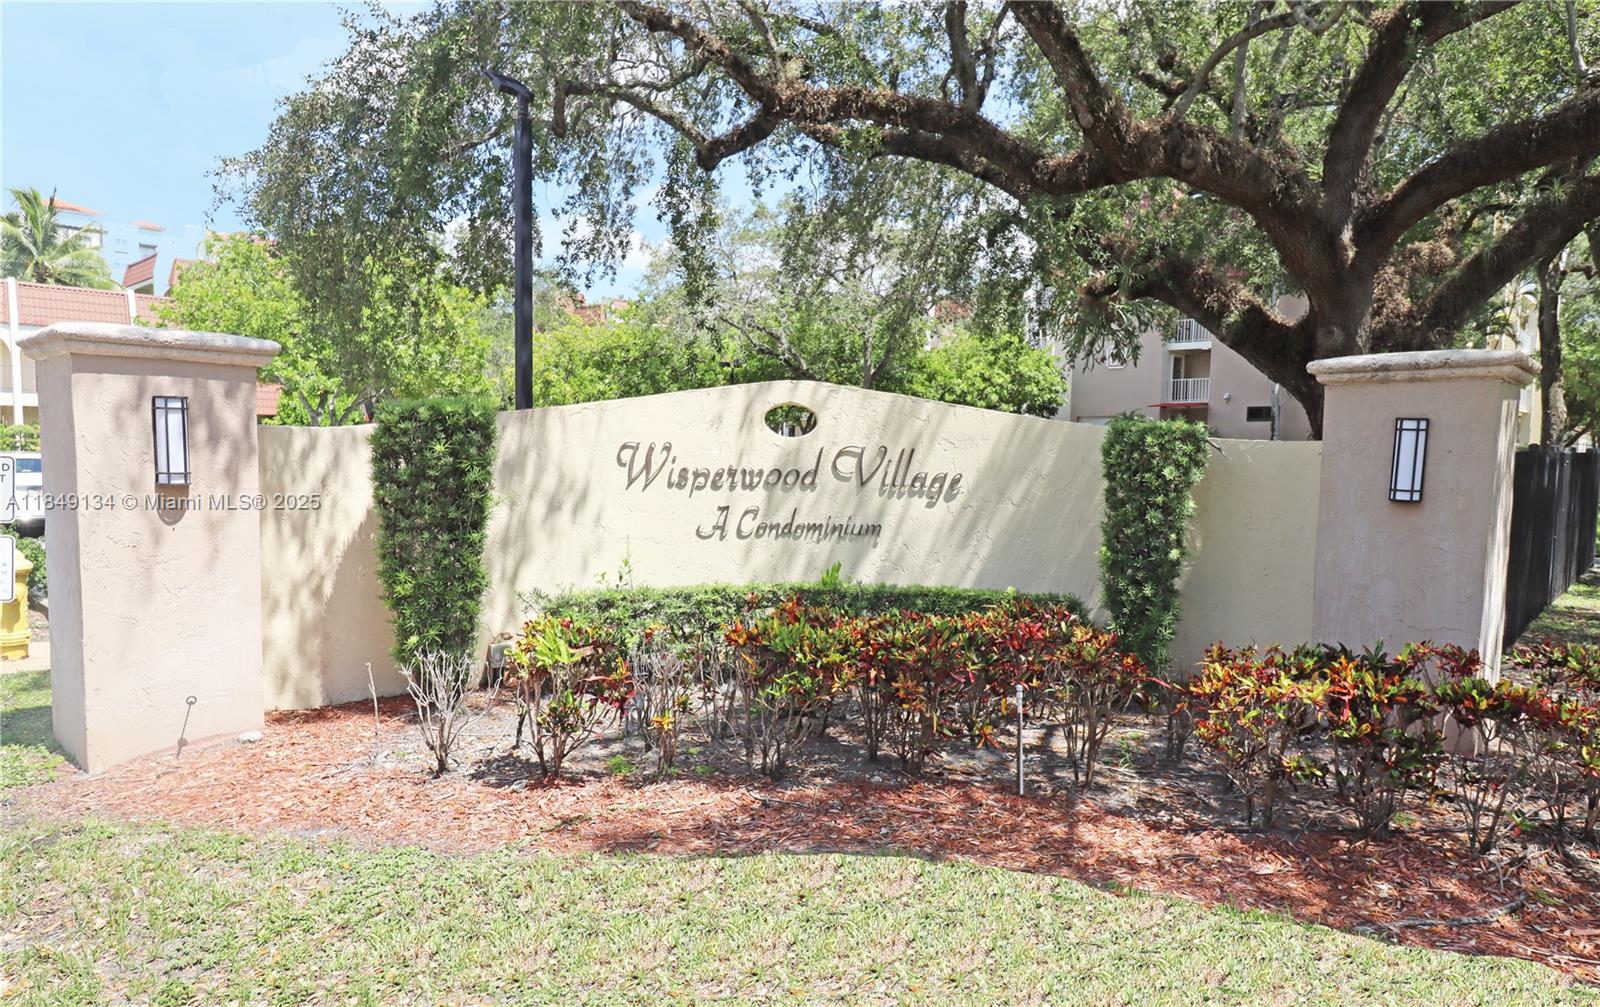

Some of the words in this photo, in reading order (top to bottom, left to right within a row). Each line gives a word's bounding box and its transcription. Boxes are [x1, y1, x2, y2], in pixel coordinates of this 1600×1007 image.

[615, 441, 823, 498] Wisperwood
[831, 445, 963, 508] Village
[696, 505, 729, 540] A
[736, 505, 882, 547] Condominium
